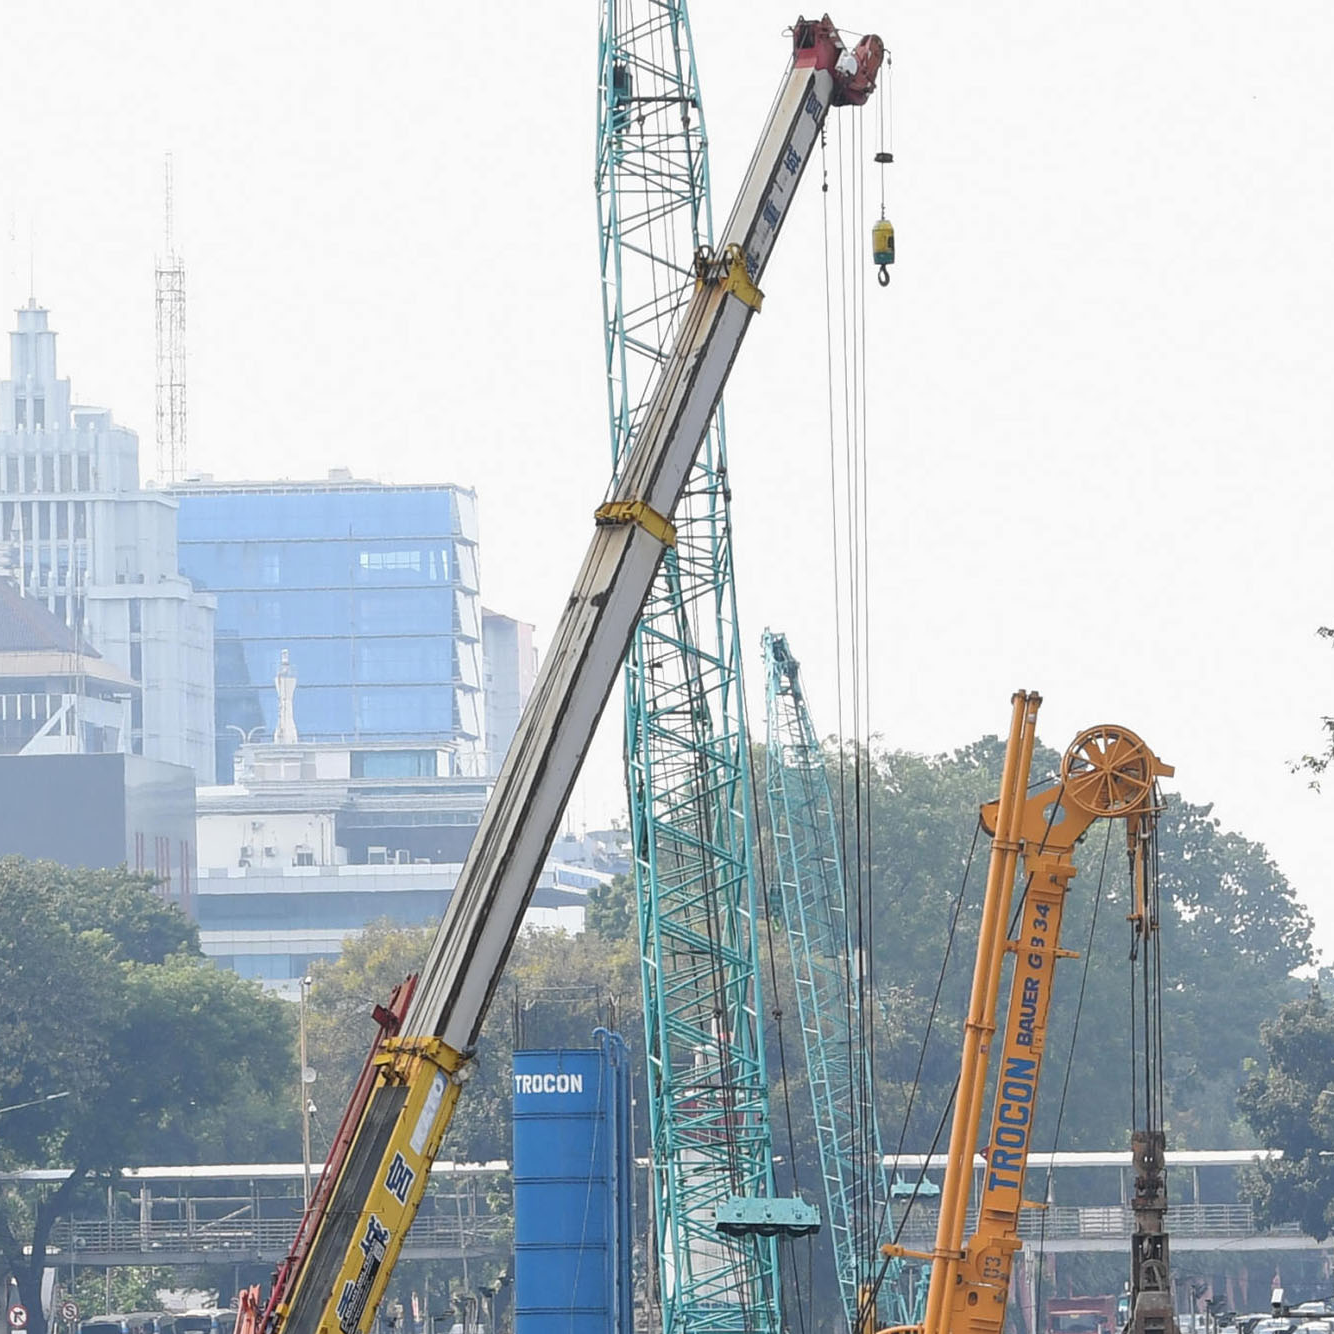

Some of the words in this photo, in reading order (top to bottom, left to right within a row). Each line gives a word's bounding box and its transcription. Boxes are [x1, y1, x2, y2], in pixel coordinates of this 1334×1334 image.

[514, 1073, 584, 1094] TROCON
[989, 1057, 1037, 1192] TROCON
[1016, 977, 1041, 1047] BAUER
[1031, 902, 1052, 933] 34
